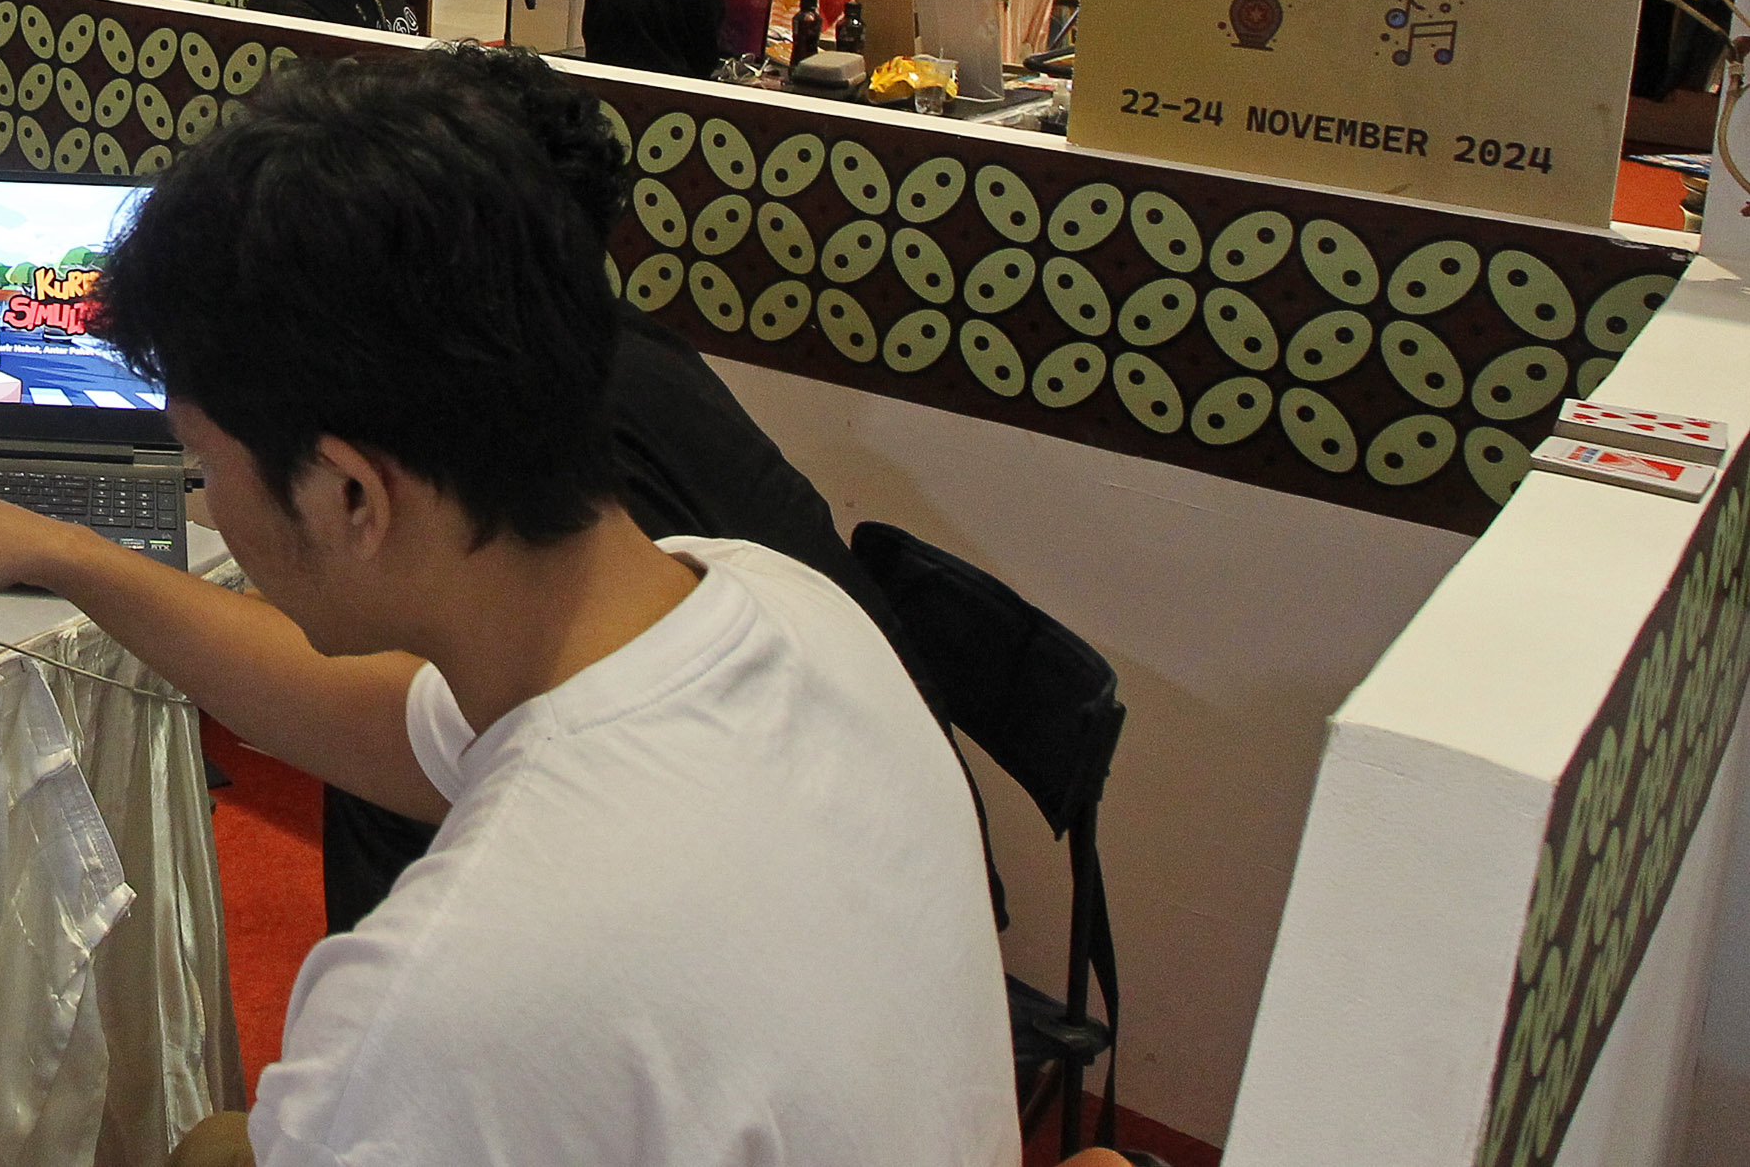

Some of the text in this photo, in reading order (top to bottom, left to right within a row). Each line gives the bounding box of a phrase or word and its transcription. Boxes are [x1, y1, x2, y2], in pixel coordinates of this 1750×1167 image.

[1120, 88, 1553, 174] 22-24 NOVEMBER 2024
